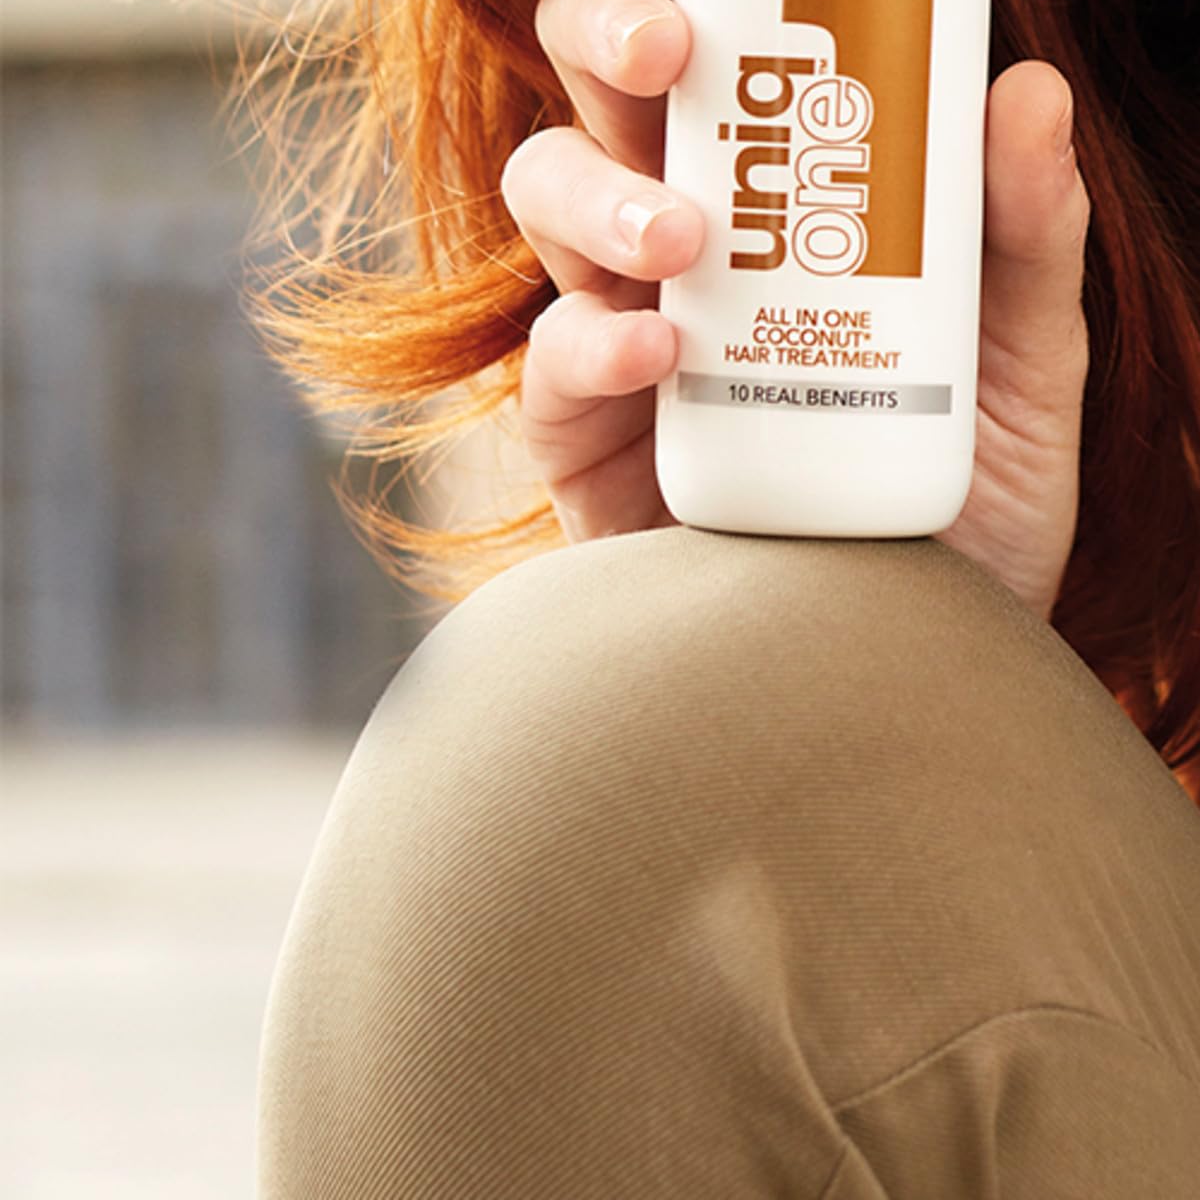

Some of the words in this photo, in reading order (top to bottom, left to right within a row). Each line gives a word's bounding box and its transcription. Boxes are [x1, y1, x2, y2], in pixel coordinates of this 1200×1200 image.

[717, 55, 815, 271] uniq
[791, 78, 871, 277] one
[754, 306, 790, 326] ALL
[796, 308, 818, 327] IN
[823, 309, 871, 329] ONE
[724, 345, 769, 364] HAIR
[777, 348, 902, 369] TREATMENT
[729, 384, 749, 402] 10
[753, 386, 800, 405] REAL
[806, 388, 898, 409] BENEFITS
